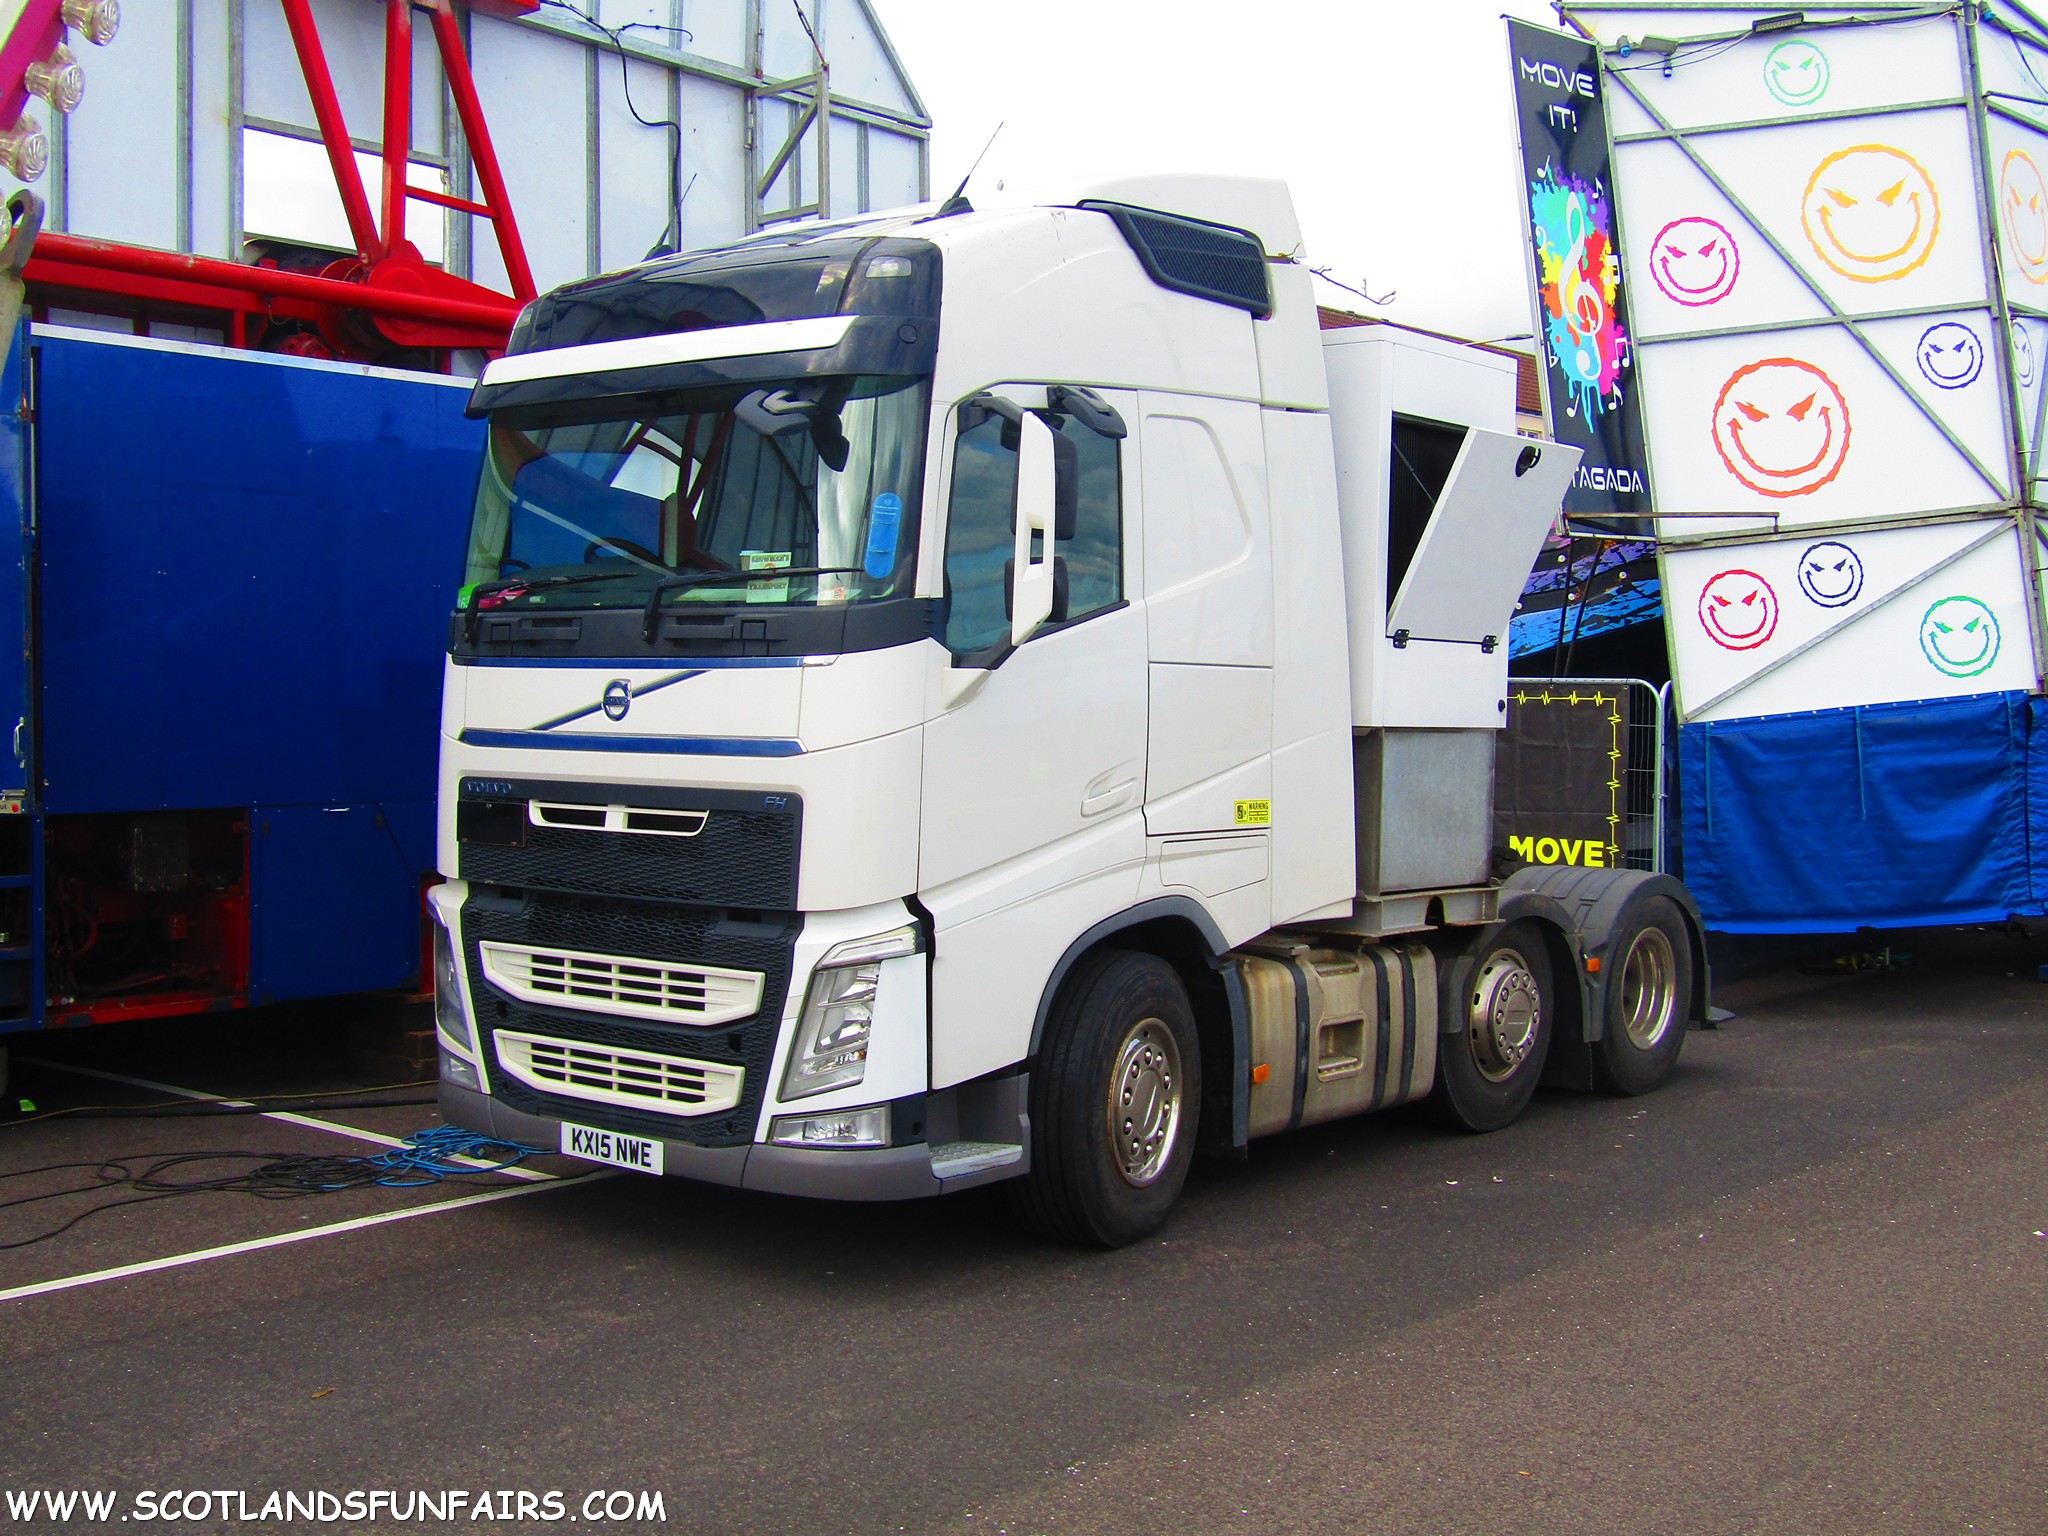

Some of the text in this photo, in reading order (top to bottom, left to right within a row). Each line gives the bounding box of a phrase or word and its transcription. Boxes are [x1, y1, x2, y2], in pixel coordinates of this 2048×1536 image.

[1519, 56, 1595, 99] MOVE
[1548, 104, 1578, 133] IT!
[1572, 465, 1644, 493] TAGADA
[763, 796, 787, 810] FH
[1249, 802, 1269, 810] WARNING
[1509, 835, 1604, 867] MOVE
[572, 1128, 652, 1168] KX15 NWE
